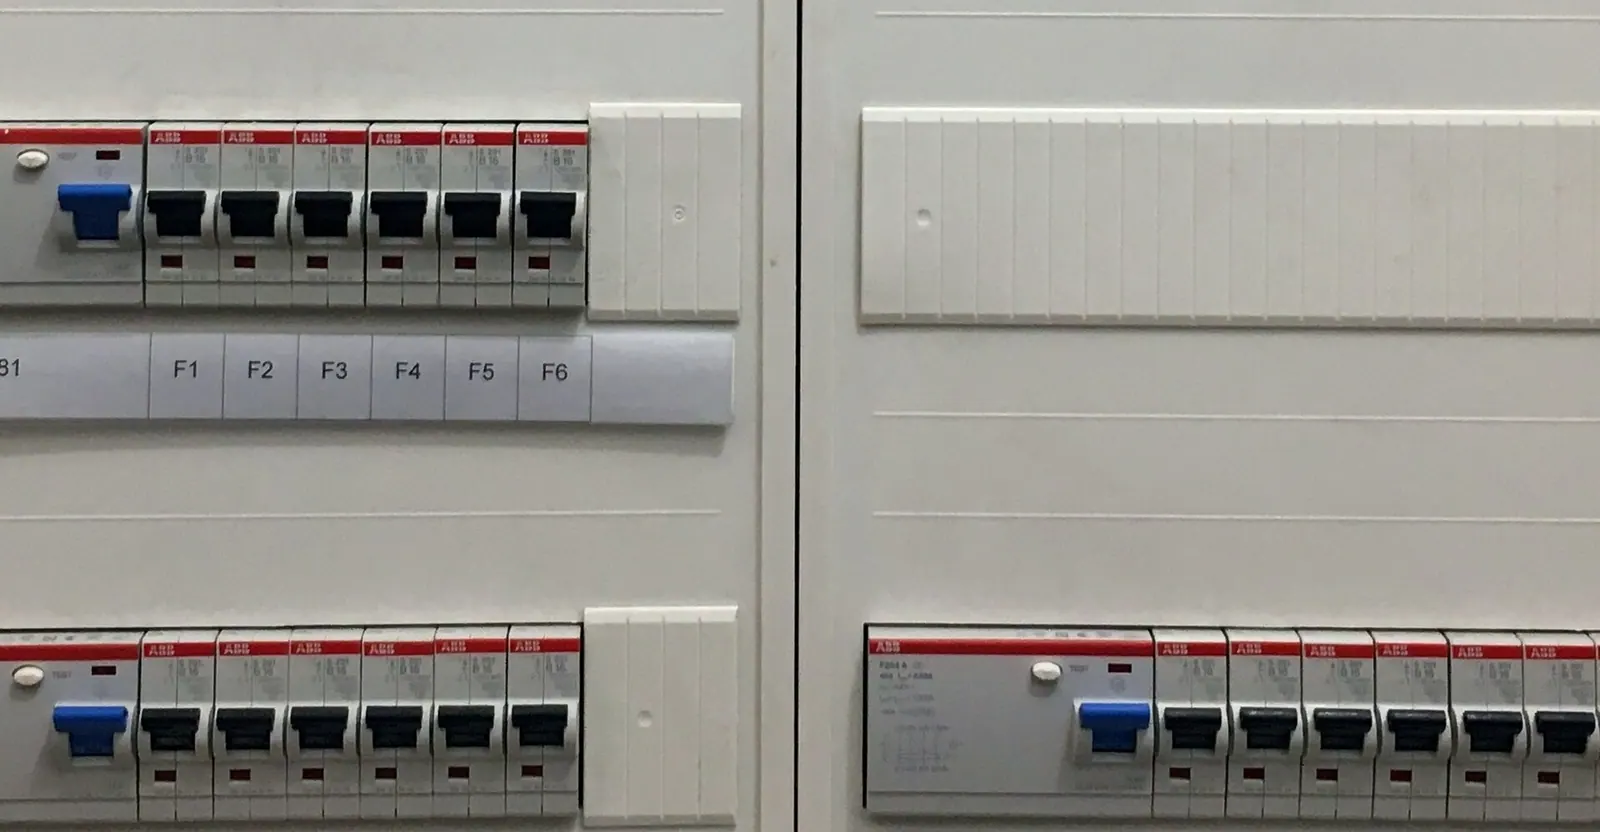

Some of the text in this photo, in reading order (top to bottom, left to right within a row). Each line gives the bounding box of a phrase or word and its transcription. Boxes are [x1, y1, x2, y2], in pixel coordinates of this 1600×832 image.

[155, 132, 181, 143] ABB
[228, 132, 254, 143] ABB
[302, 132, 327, 143] ABB
[376, 133, 402, 144] ABB
[449, 133, 475, 144] ABB
[523, 133, 549, 144] ABB
[174, 359, 197, 379] F1
[248, 360, 273, 380] F2
[321, 361, 348, 380] F3
[395, 361, 421, 381] F4
[469, 362, 495, 382] F5
[542, 362, 568, 383] F6
[149, 645, 175, 656] ABB
[224, 643, 250, 655] ABB
[296, 642, 322, 654] ABB
[369, 644, 395, 655] ABB
[441, 641, 467, 652] ABB
[514, 640, 540, 652] ABB
[876, 640, 901, 653] ABB
[1162, 644, 1188, 655] ABB
[1236, 643, 1262, 654] ABB
[1310, 645, 1336, 657] ABB
[1383, 644, 1409, 656] ABB
[1457, 646, 1483, 658] ABB
[1531, 647, 1557, 658] ABB
